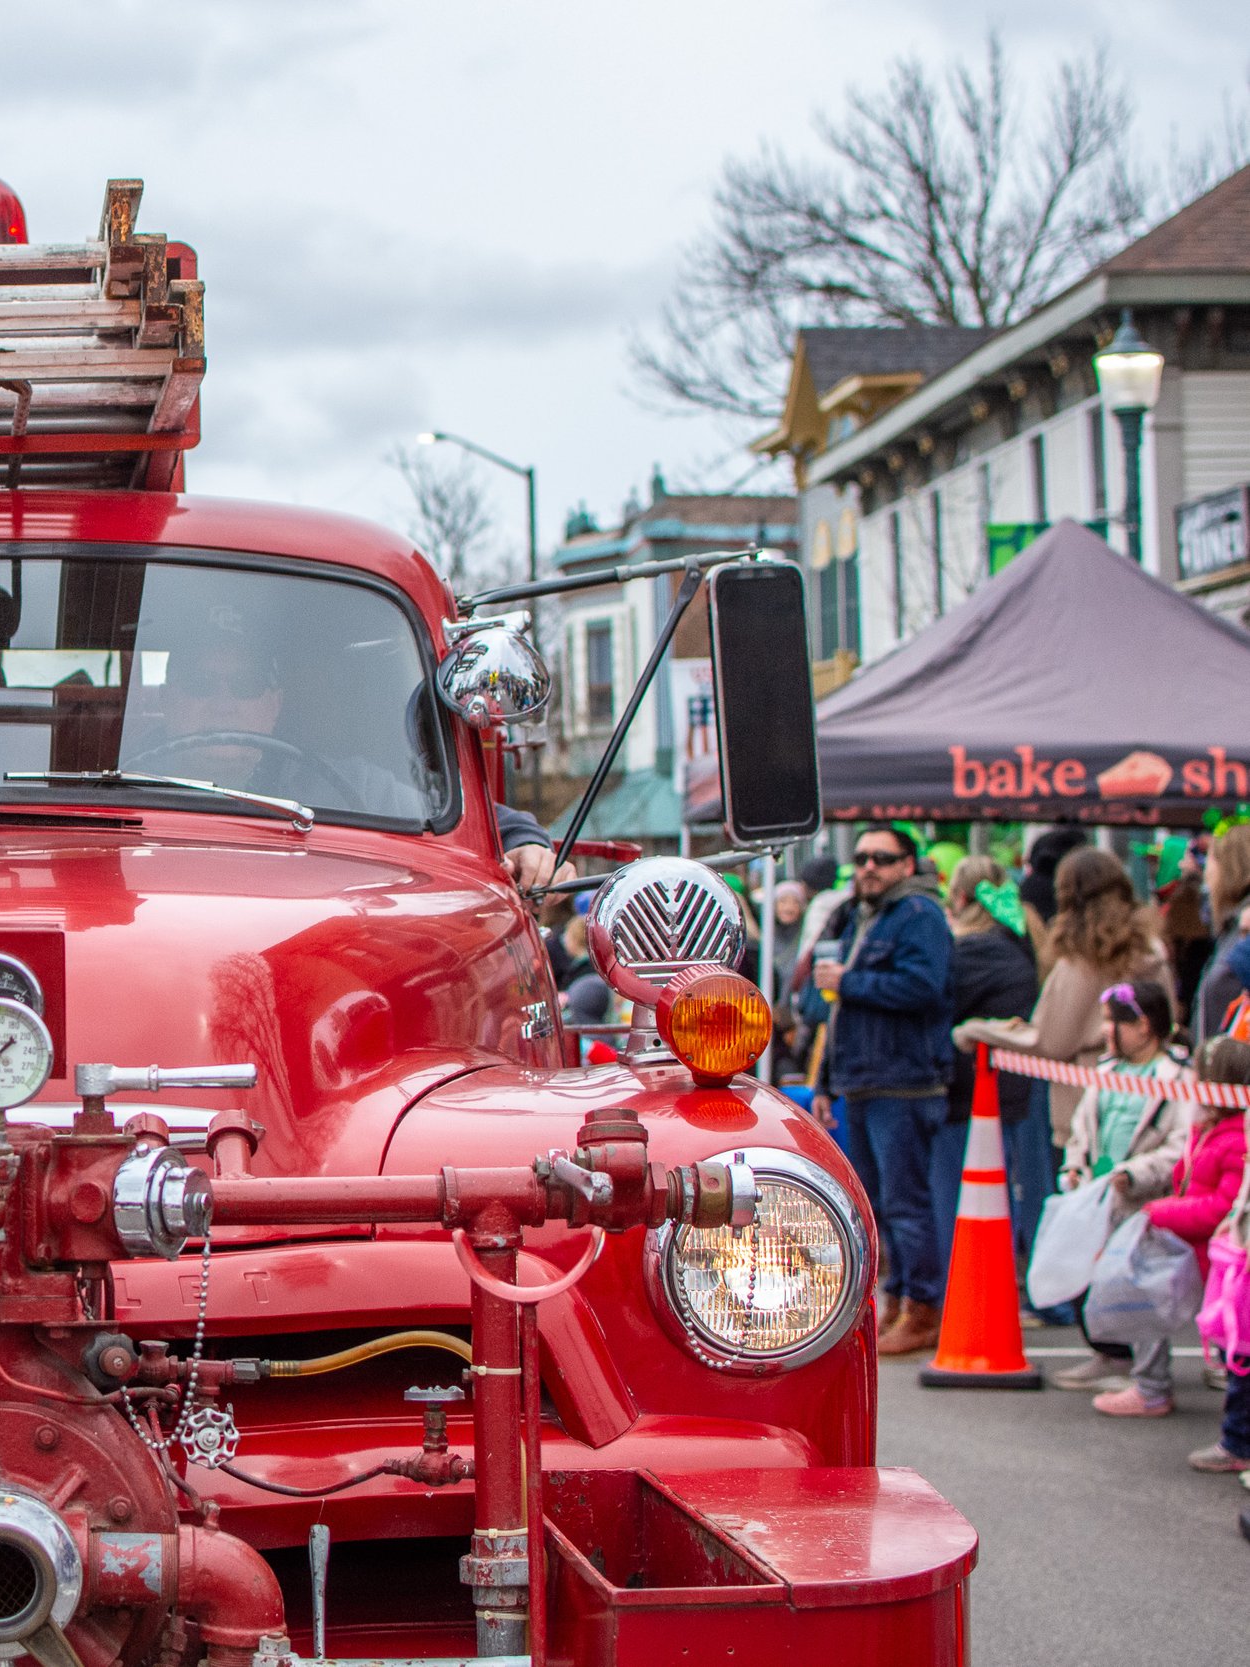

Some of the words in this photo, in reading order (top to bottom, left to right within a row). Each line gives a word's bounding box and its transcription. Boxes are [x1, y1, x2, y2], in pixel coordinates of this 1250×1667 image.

[949, 745, 1087, 798] bake
[2, 972, 14, 980] 30
[14, 994, 25, 1003] 40
[8, 1021, 20, 1029] 180
[20, 1032, 31, 1040] 210
[23, 1047, 37, 1055] 240
[22, 1062, 35, 1070] 270
[11, 1075, 25, 1084] 300
